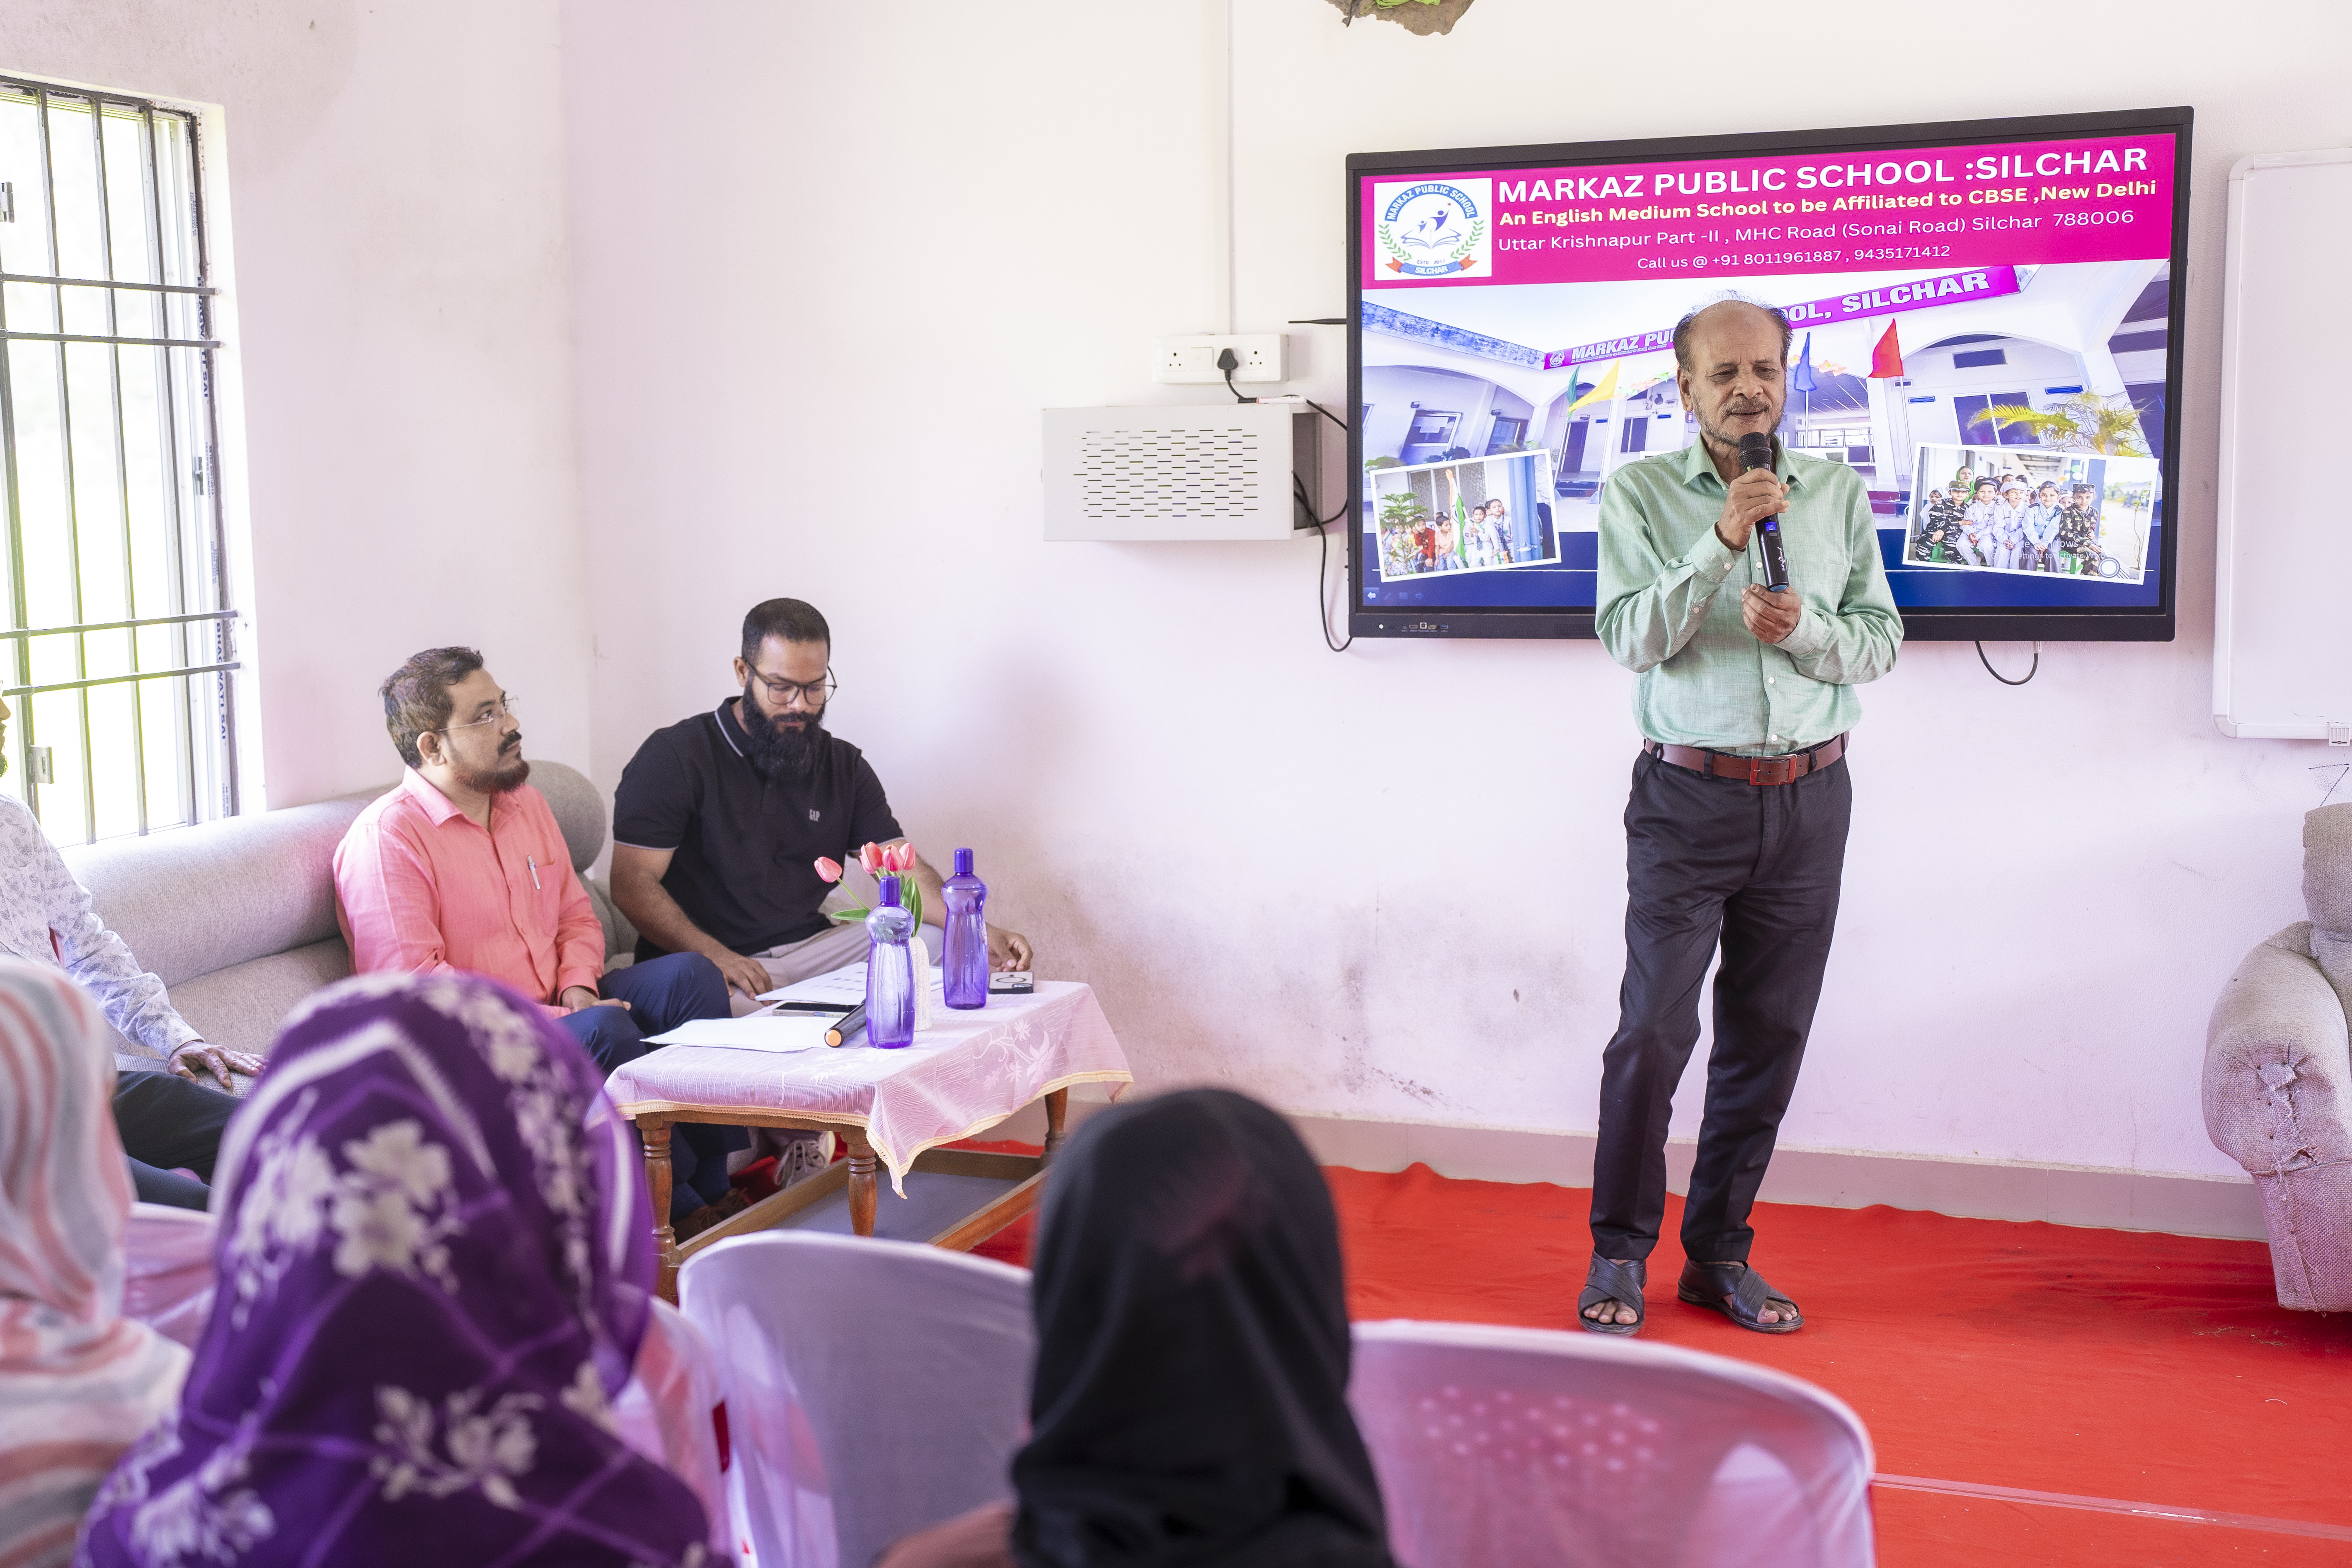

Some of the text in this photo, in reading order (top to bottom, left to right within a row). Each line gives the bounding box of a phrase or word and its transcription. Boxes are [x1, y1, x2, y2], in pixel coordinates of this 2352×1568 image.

[1499, 148, 2147, 203] MARKAZ PUBLIC SCHOOL :SILCHAR
[1387, 184, 1476, 220] MARKAZ PUBLIC SCHOOL
[1499, 212, 1526, 226] An
[1532, 208, 1603, 227] English
[1609, 205, 1691, 221] Medium
[1696, 200, 1768, 217] School
[1773, 201, 1795, 214] to
[1801, 198, 1827, 212] be
[1832, 192, 1933, 211] Affiliated
[1939, 193, 1962, 206] to
[1969, 188, 2027, 204] CBSE
[2097, 180, 2156, 197] Delhi
[1499, 238, 1546, 251] Uttar
[1551, 235, 1652, 249] Krishnapur
[1657, 232, 1696, 245] Part
[1736, 227, 1781, 241] MHC
[1788, 224, 1835, 239] Road
[1843, 221, 1902, 238] (Sonai
[1909, 218, 1965, 233] Road)
[1972, 216, 2042, 230] Silchar
[2053, 210, 2134, 226] 788006
[1415, 266, 1449, 274] SILCHAR
[1637, 257, 1667, 269] Call
[1671, 259, 1688, 267] us
[1693, 256, 1708, 268] @
[1712, 254, 1739, 266] +91
[1744, 250, 1841, 265] 8011961887
[1854, 245, 1950, 260] 9435171412
[1571, 336, 1640, 360] MARKAZ
[1841, 272, 1990, 313] SILCHAR
